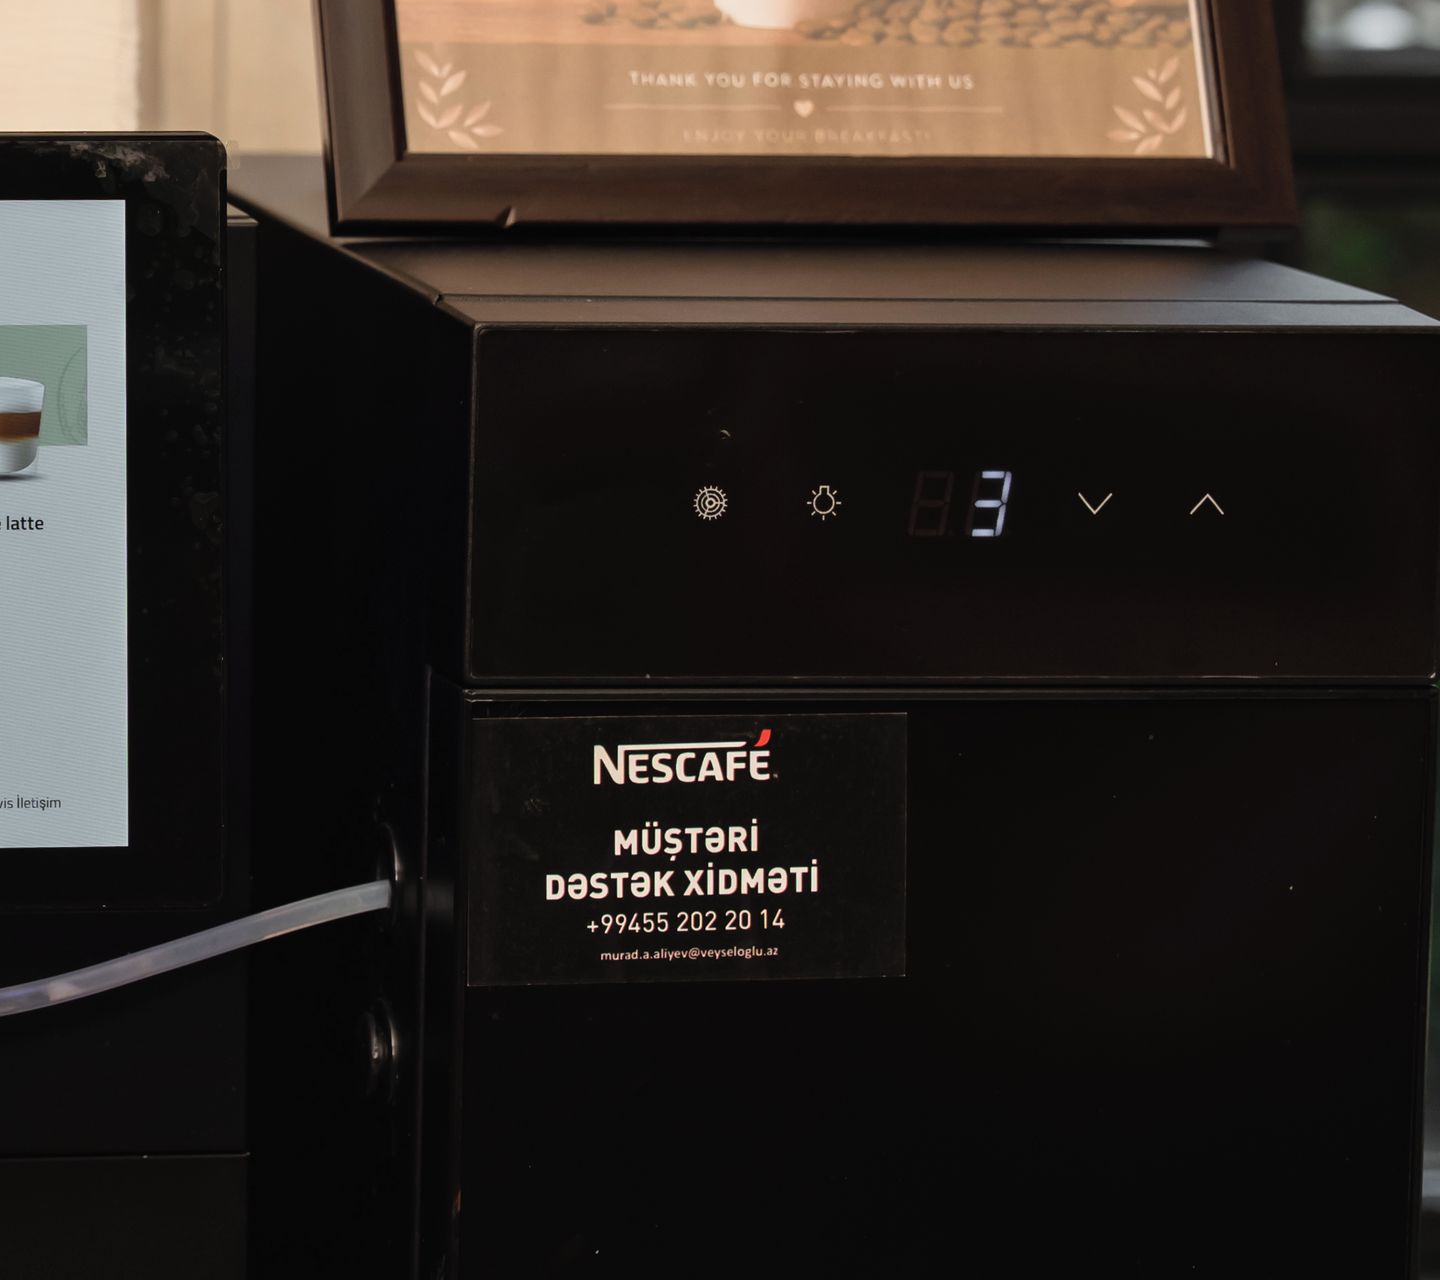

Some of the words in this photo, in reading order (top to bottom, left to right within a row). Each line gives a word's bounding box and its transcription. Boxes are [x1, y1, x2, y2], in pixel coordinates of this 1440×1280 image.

[629, 70, 697, 88] THANK
[704, 72, 747, 89] YOU
[751, 71, 791, 89] FOR
[798, 73, 884, 90] STAYING
[890, 74, 942, 90] WITH
[948, 74, 975, 91] US
[6, 515, 44, 531] latte
[593, 728, 772, 785] NESCAFÉ
[16, 794, 62, 811] İletişim
[614, 818, 759, 862] MÜŞTƏRİ
[545, 870, 675, 901] DƏSTƏK
[683, 858, 819, 897] XİDMƏTİ
[586, 911, 669, 934] +99455
[676, 910, 717, 932] 202
[724, 909, 752, 931] 20
[760, 908, 785, 929] 14
[600, 945, 779, 961] murad.a.aliyev@veyseloglu.az
